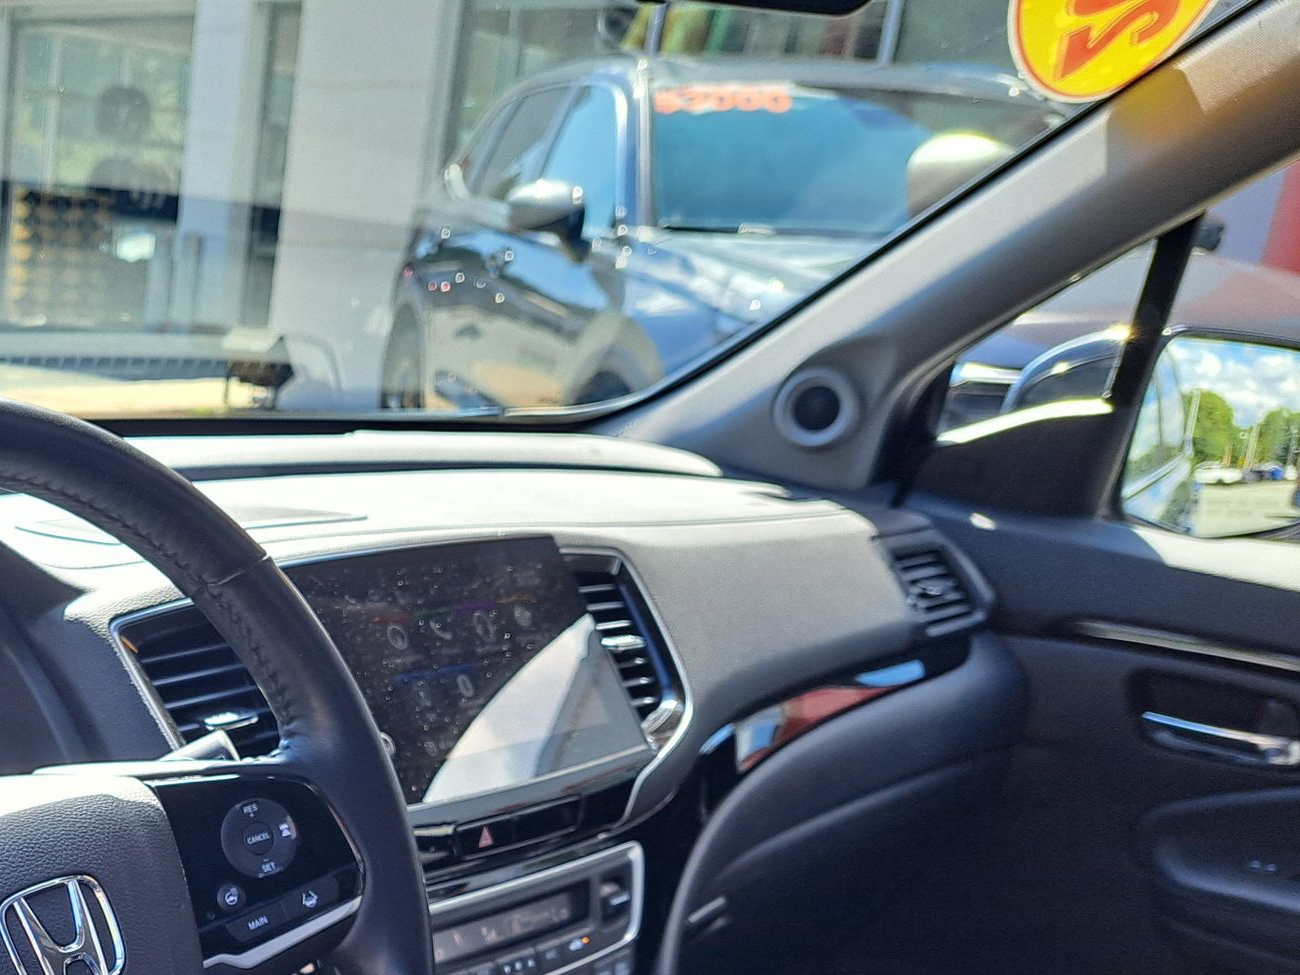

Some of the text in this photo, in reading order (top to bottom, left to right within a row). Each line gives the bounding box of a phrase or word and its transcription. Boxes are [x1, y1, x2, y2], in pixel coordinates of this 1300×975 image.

[243, 803, 258, 815] RES
[246, 832, 270, 845] CANCEL
[261, 861, 276, 873] SET
[248, 916, 268, 930] MAIN
